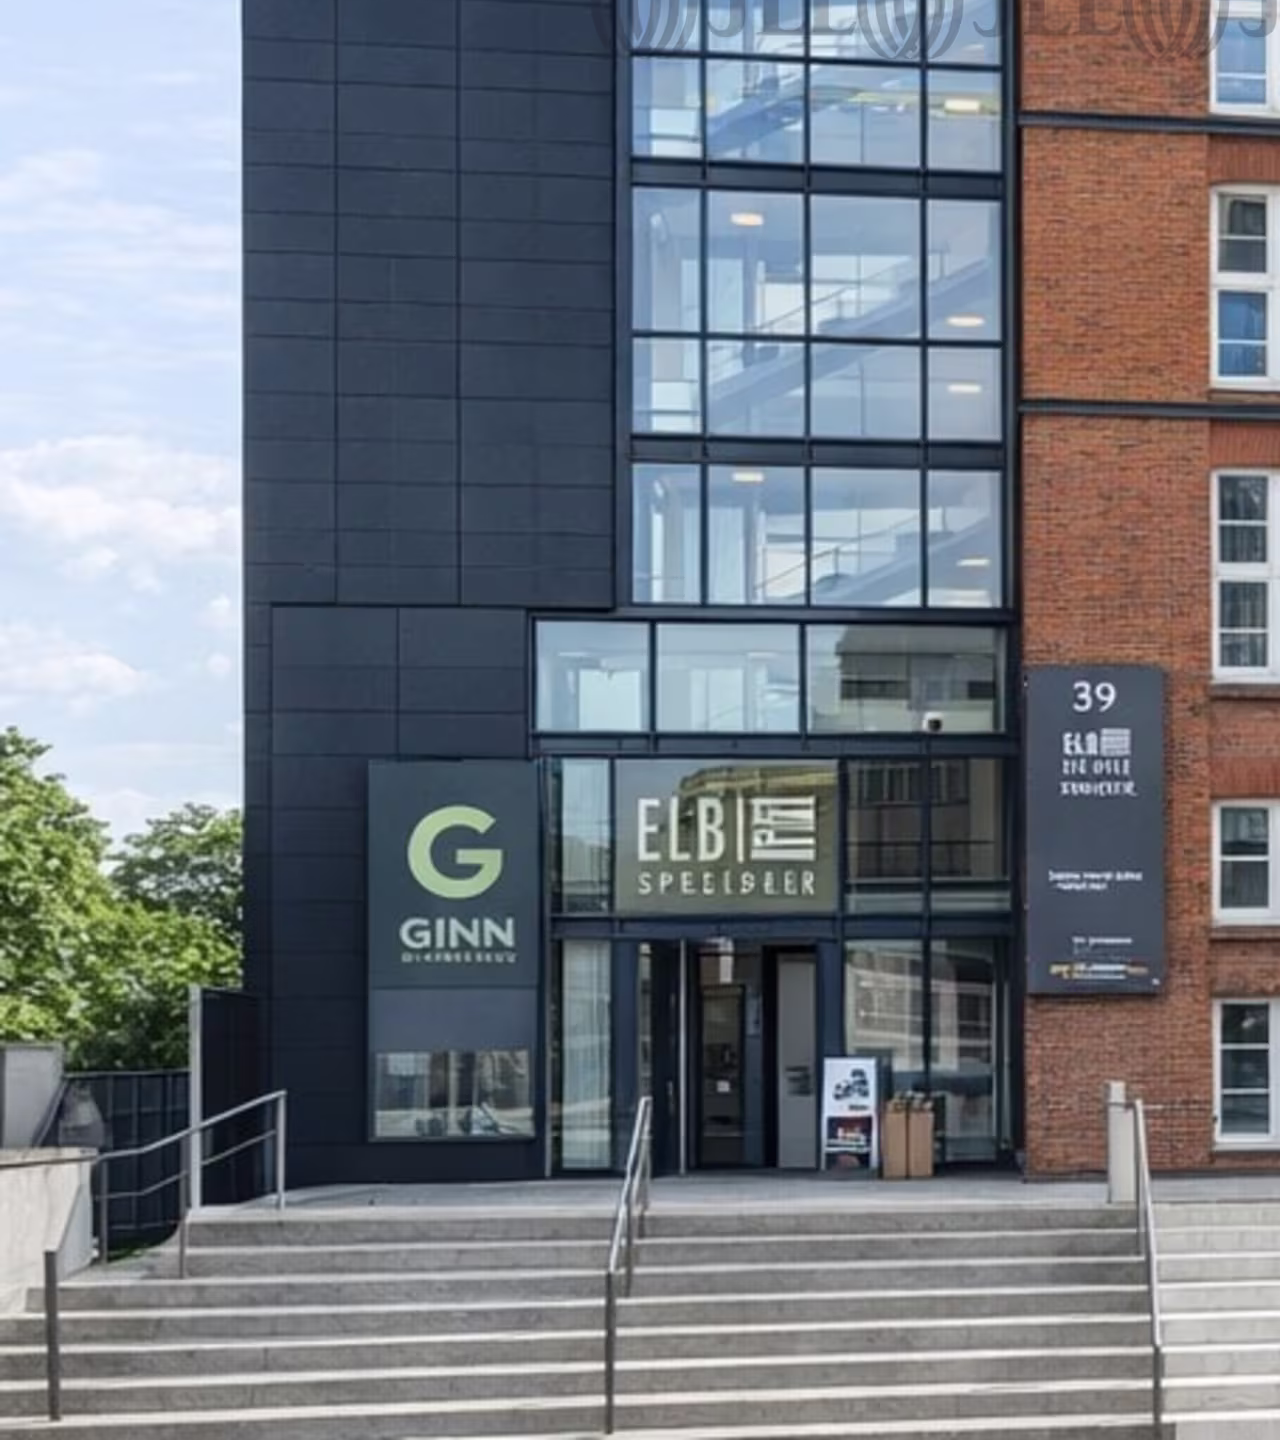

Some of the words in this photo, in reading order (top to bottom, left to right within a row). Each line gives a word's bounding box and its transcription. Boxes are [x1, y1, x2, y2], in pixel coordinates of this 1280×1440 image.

[1072, 681, 1117, 712] 39
[637, 796, 726, 862] ELB
[400, 917, 515, 949] GINN
